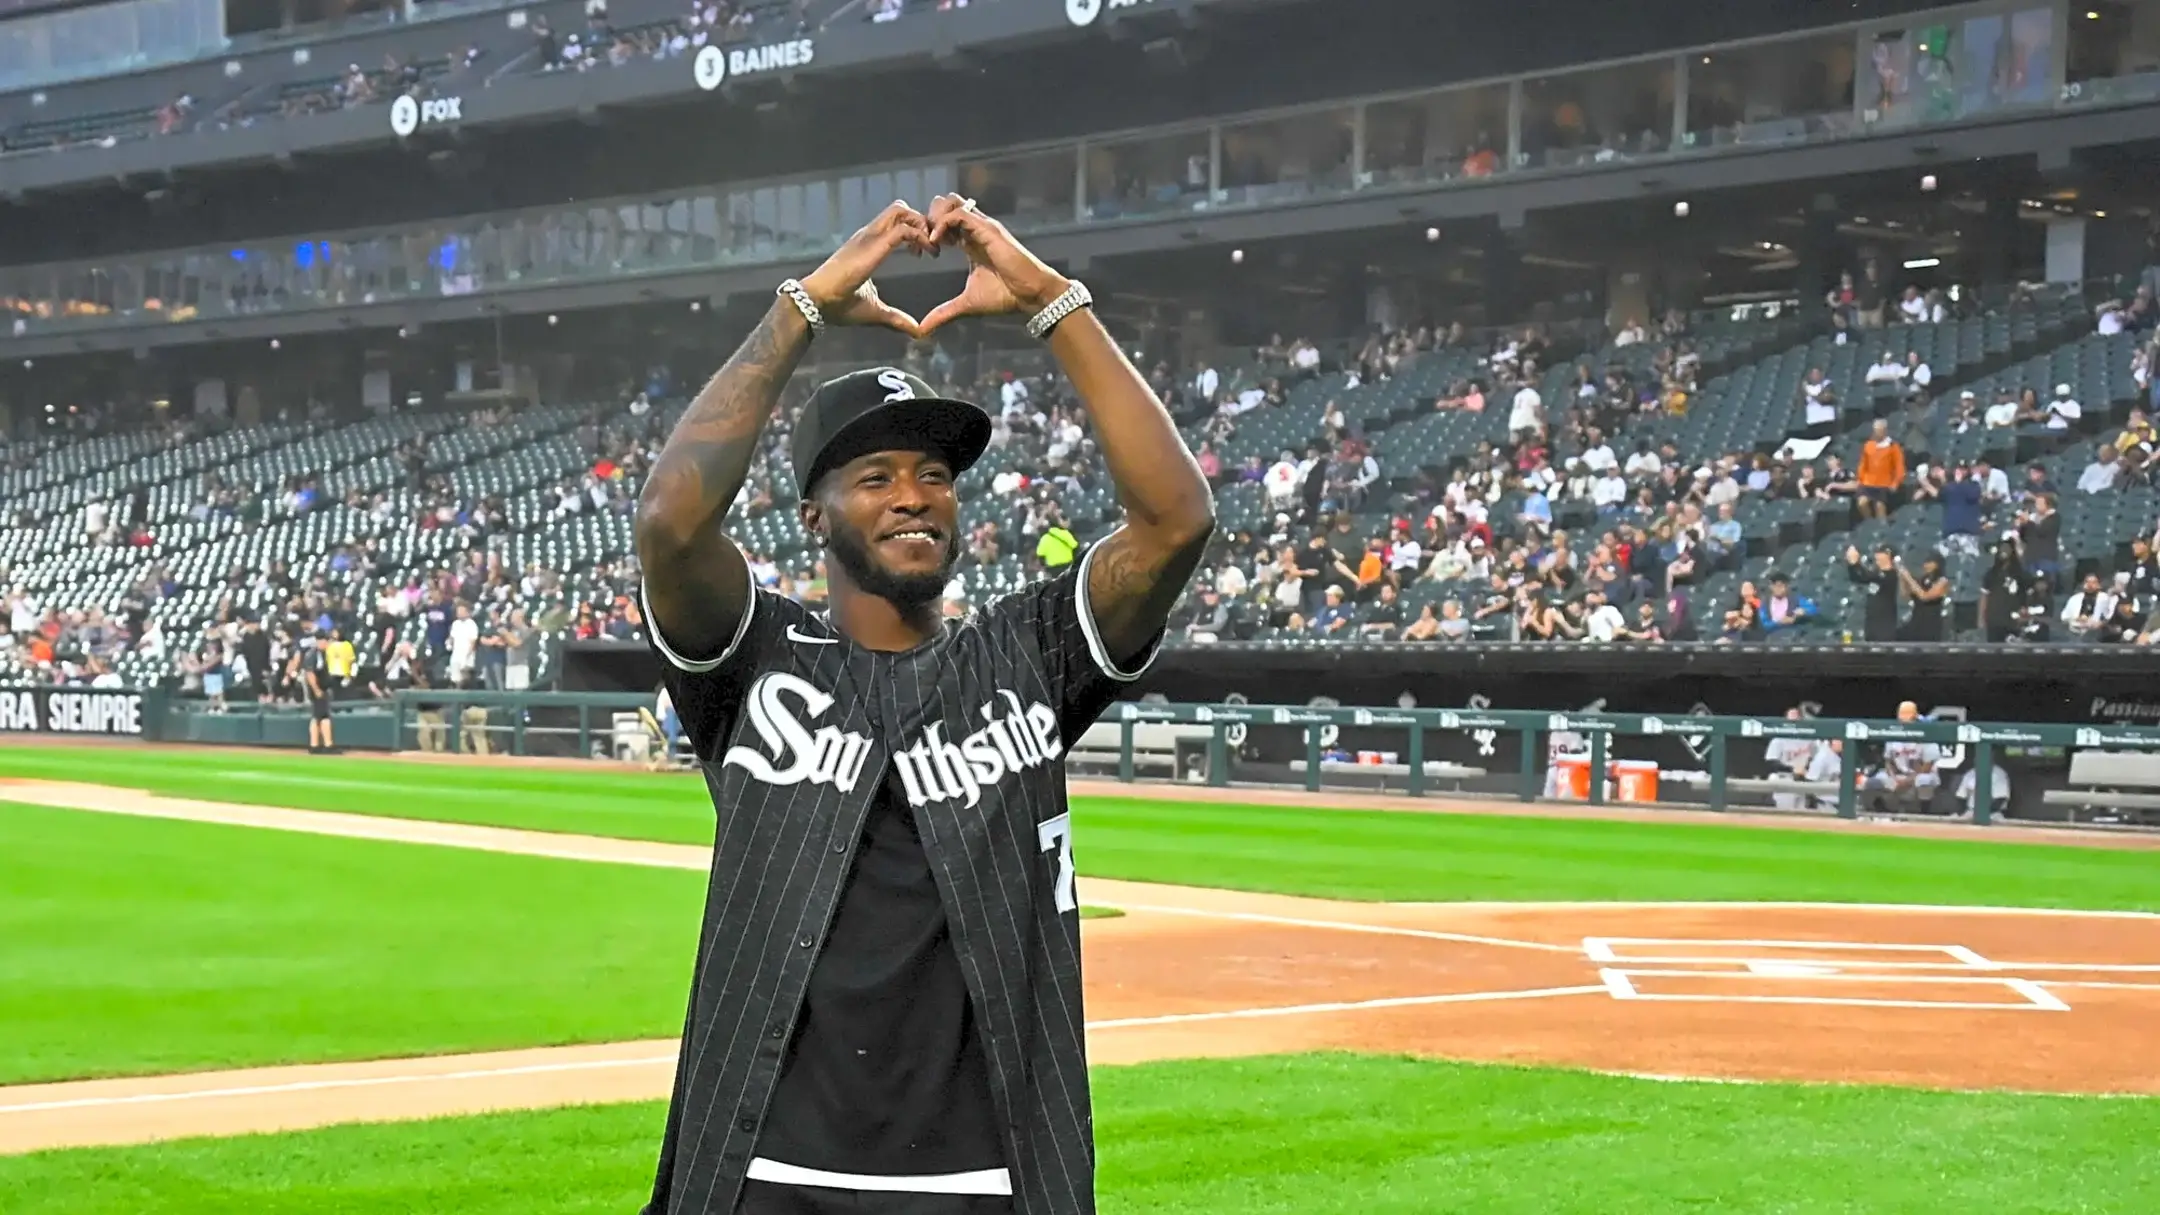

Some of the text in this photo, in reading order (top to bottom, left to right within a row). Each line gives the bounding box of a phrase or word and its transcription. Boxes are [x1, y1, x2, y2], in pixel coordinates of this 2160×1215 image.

[728, 38, 814, 75] BAINES
[421, 96, 462, 123] FOX
[0, 691, 142, 733] RA SIEMPRE
[1037, 812, 1076, 914] 7
